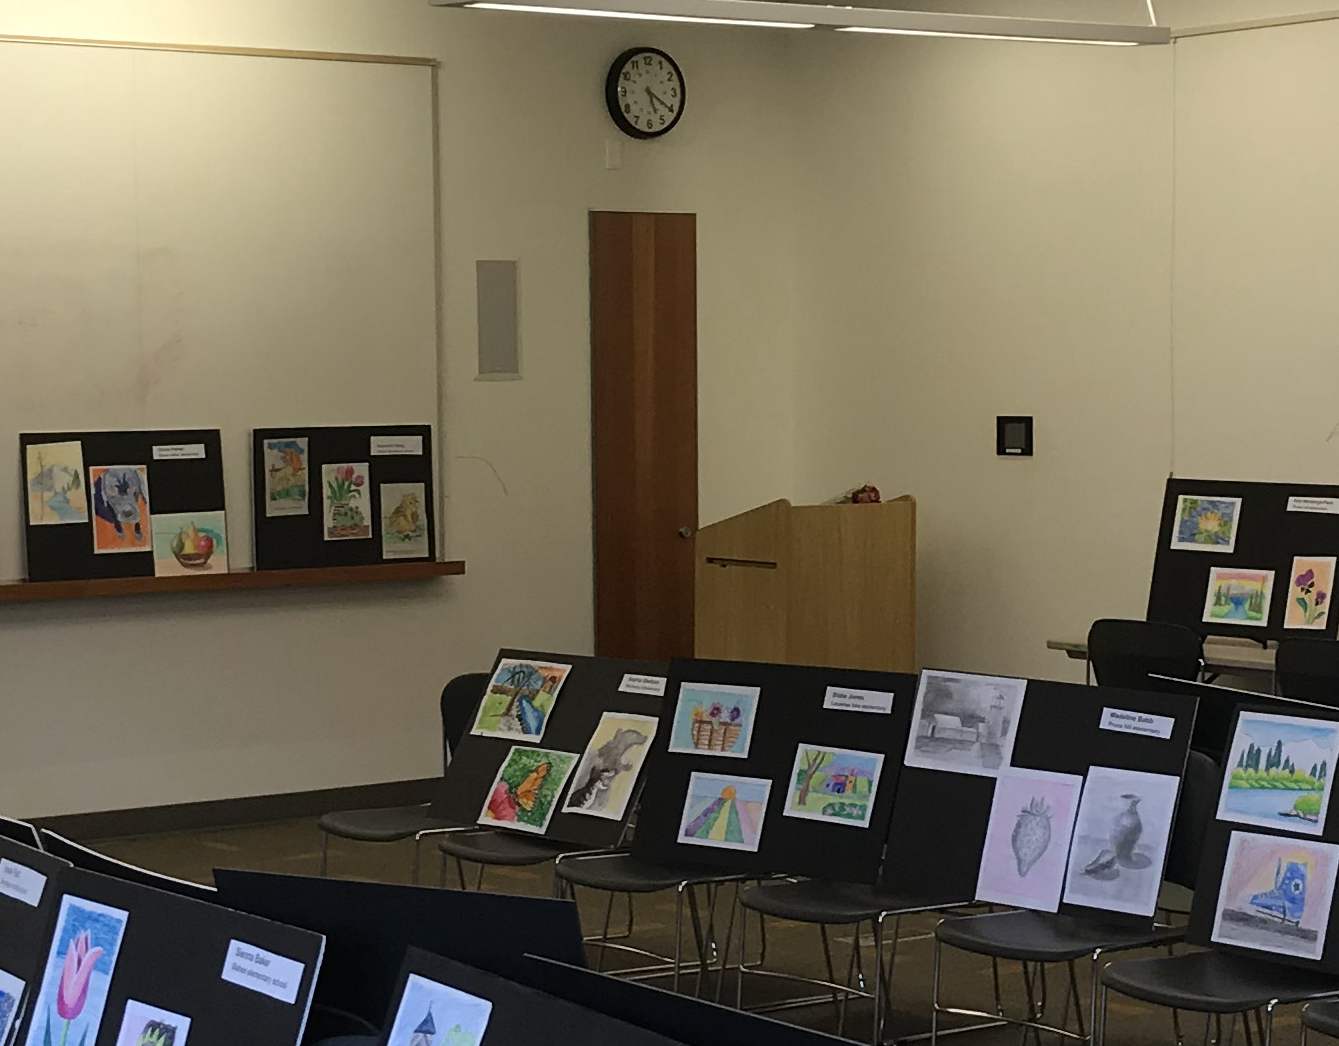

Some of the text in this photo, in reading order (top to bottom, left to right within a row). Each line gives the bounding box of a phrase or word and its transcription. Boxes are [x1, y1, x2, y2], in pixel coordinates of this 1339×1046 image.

[631, 60, 639, 70] 11
[643, 56, 653, 66] 12
[659, 60, 663, 70] 1
[623, 71, 631, 81] 10
[667, 71, 673, 82] 2
[621, 86, 627, 97] 9
[671, 87, 677, 98] 3
[625, 103, 631, 114] 8
[634, 116, 640, 125] 7
[647, 119, 653, 129] 6
[660, 115, 665, 125] 5
